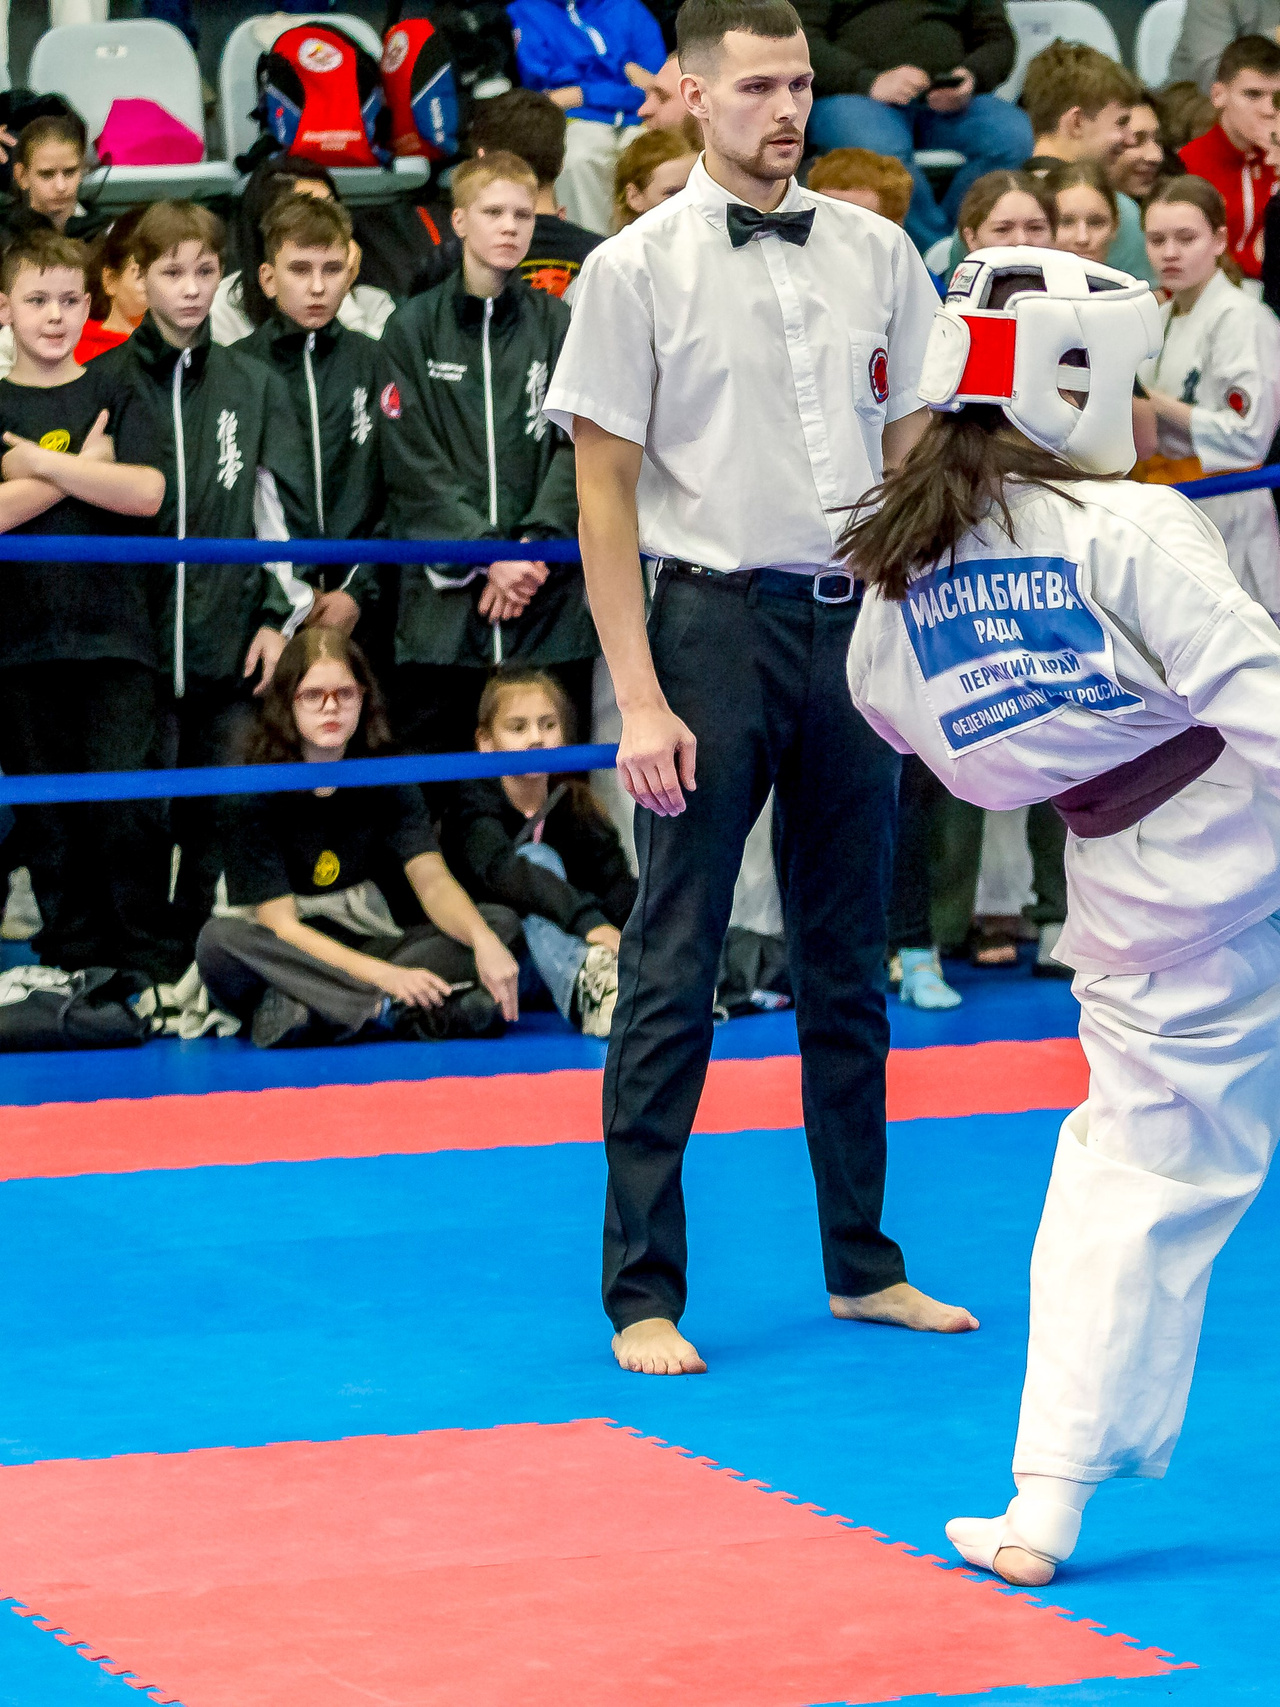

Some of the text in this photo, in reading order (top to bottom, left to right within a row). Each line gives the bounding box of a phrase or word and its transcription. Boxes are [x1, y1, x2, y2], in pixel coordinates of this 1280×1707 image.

[909, 571, 1083, 633] МАСНАБИЕВА
[973, 617, 1024, 644] РАДА
[1038, 651, 1081, 675] КРАЙ
[952, 698, 1020, 737] ФЕДЕРАЦИЯ
[1077, 682, 1125, 704] РОССИ
